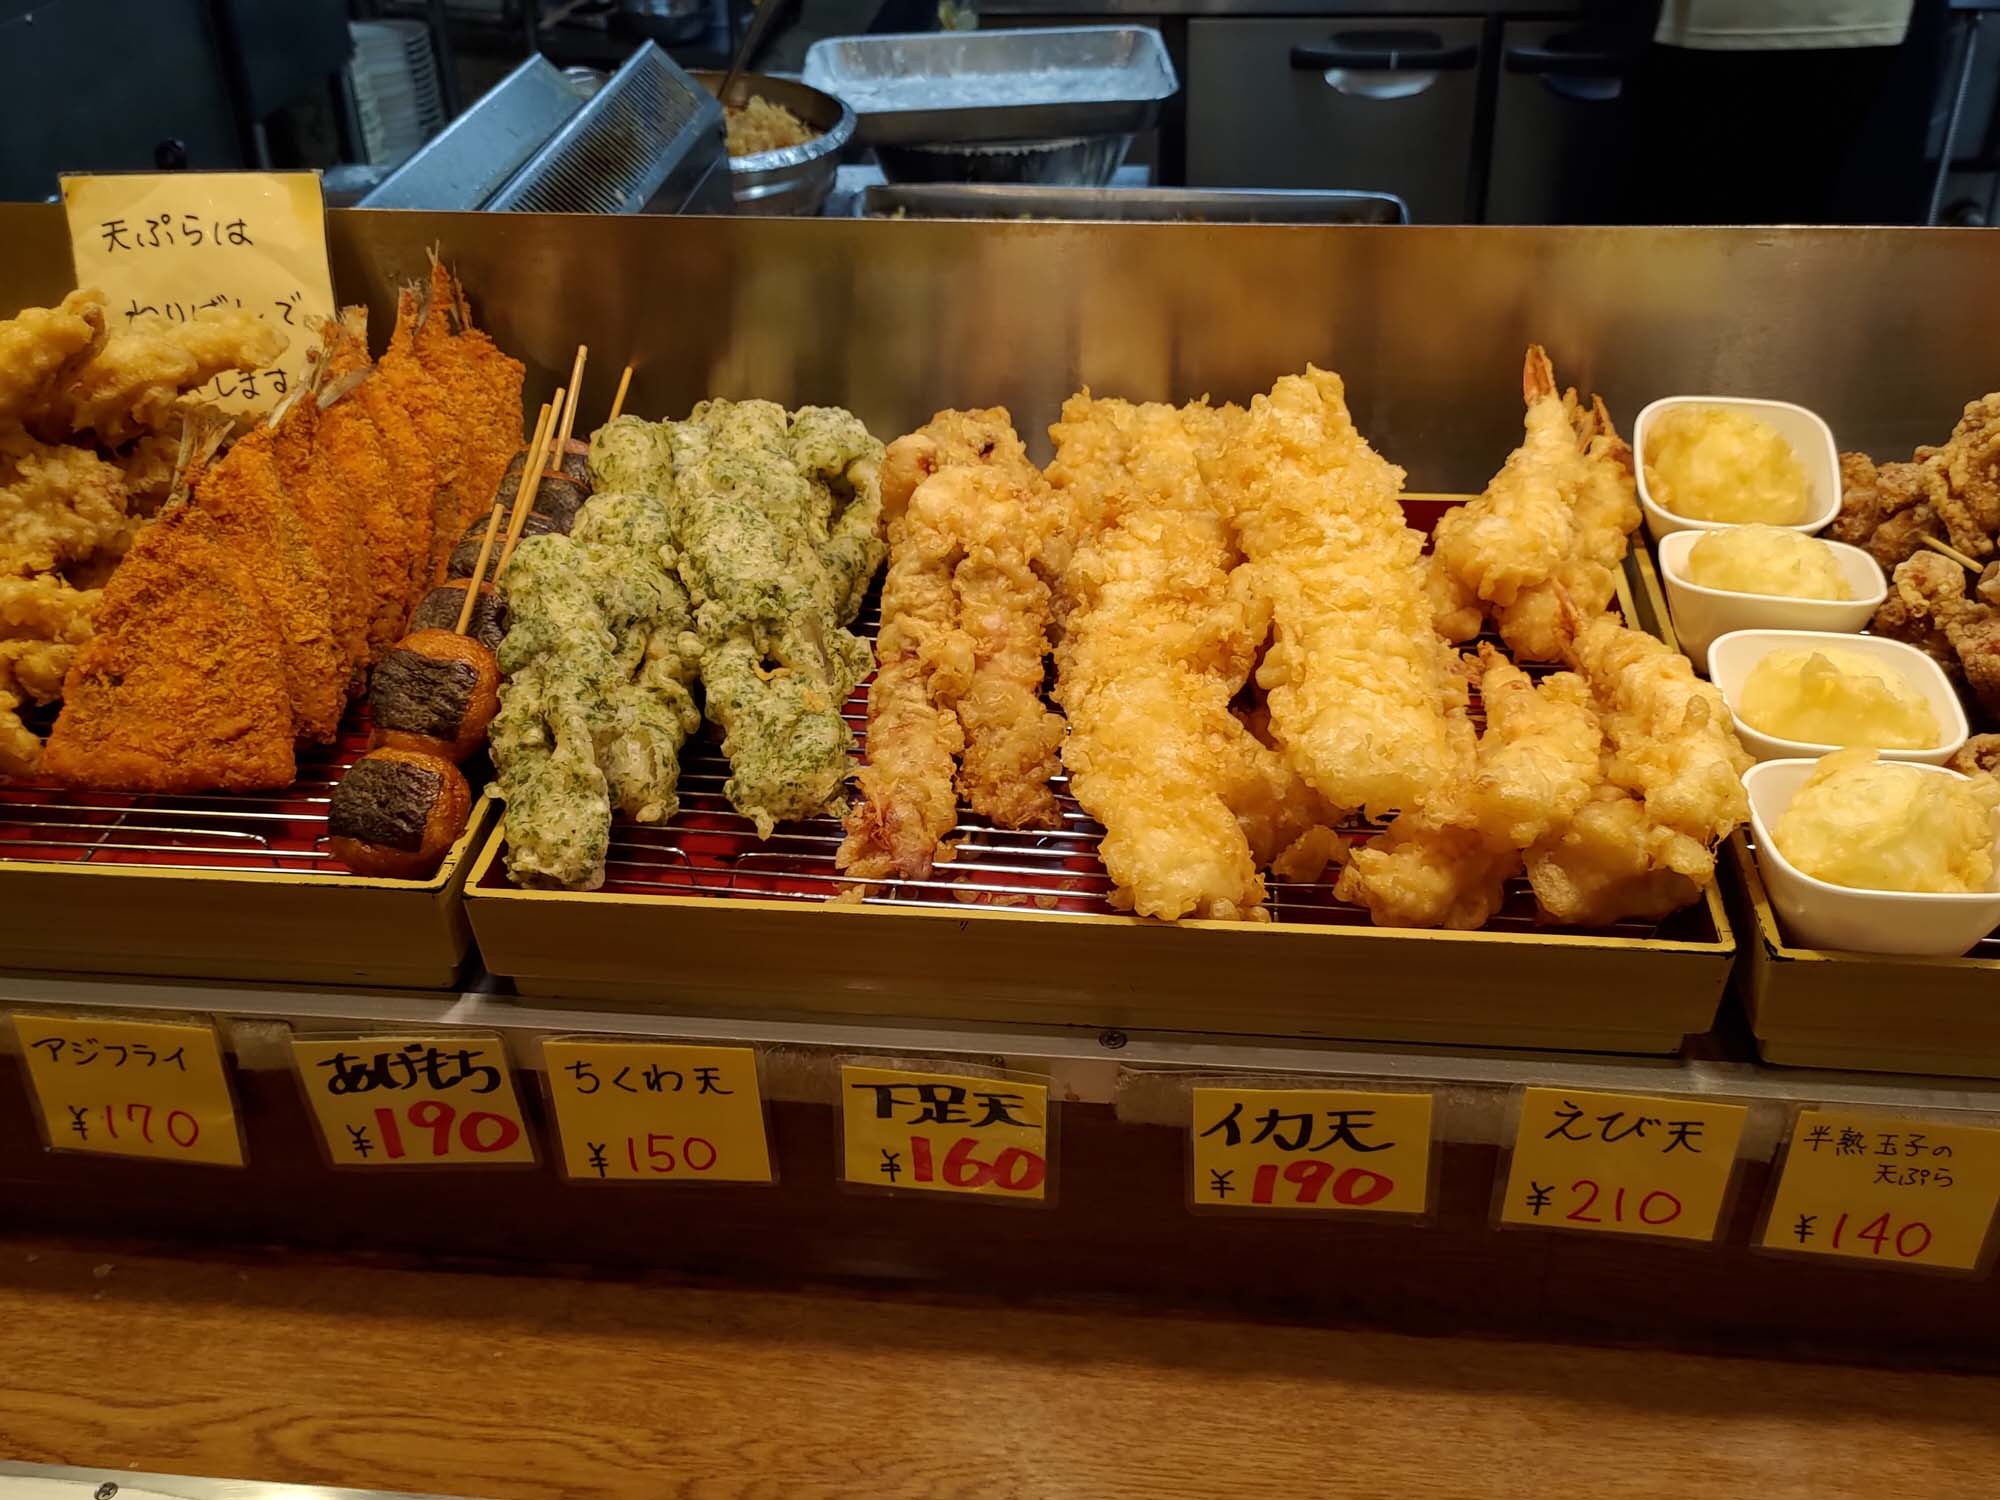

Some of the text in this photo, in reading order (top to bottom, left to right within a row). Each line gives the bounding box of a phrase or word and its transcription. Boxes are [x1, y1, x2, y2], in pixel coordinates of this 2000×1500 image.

[102, 214, 253, 252] 天ぷらは
[32, 1037, 187, 1071] アジフライ
[316, 1044, 501, 1095] あげもち
[565, 1060, 734, 1094] ちくわ天
[851, 1081, 1041, 1128] 下足天
[1200, 1103, 1395, 1152] イカ天
[1544, 1100, 1705, 1153] えび天
[1804, 1124, 1953, 1158] 半熟玉子の
[1872, 1164, 1954, 1187] 天ぷら
